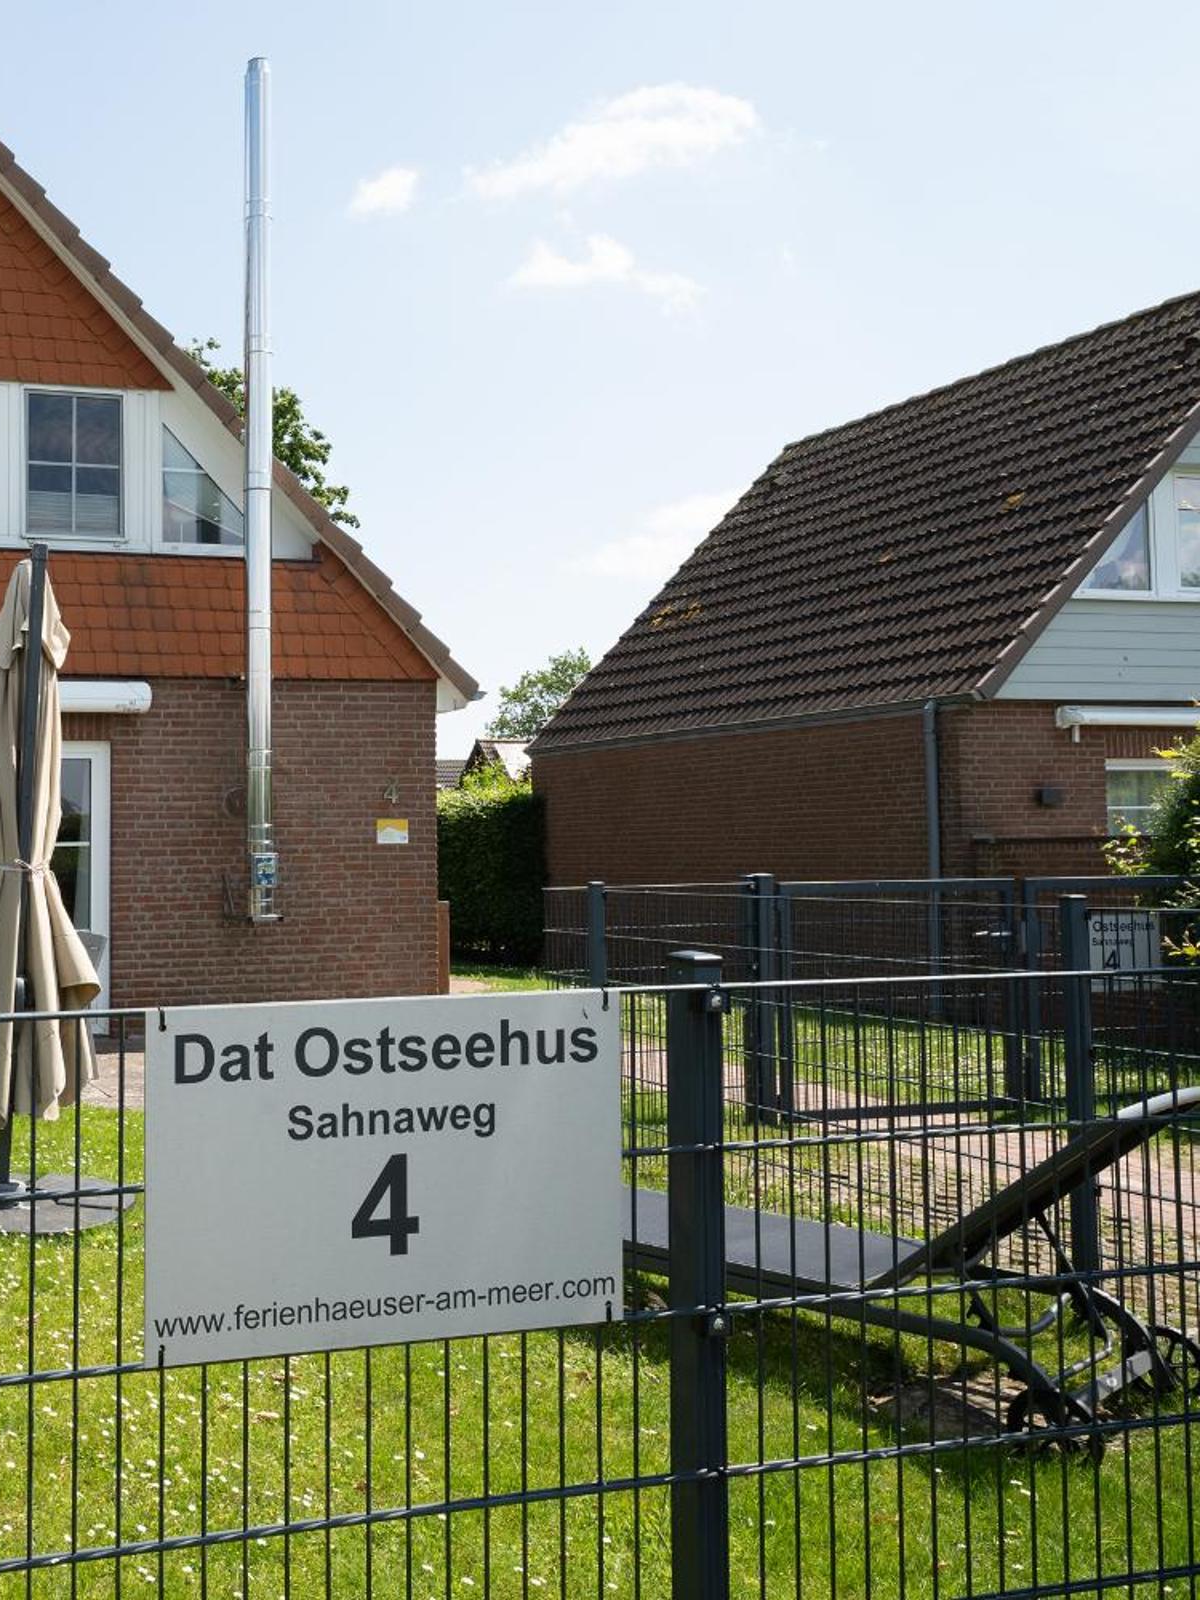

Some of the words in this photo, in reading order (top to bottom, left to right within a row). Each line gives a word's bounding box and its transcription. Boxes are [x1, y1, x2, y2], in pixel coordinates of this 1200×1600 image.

[1105, 949, 1119, 969] 4
[174, 1031, 274, 1084] Dat
[294, 1019, 598, 1078] Ostseehus
[287, 1103, 497, 1141] Sahnaweg
[351, 1153, 420, 1256] 4
[154, 1276, 616, 1339] www.ferienhaeuser-am-meer.com
